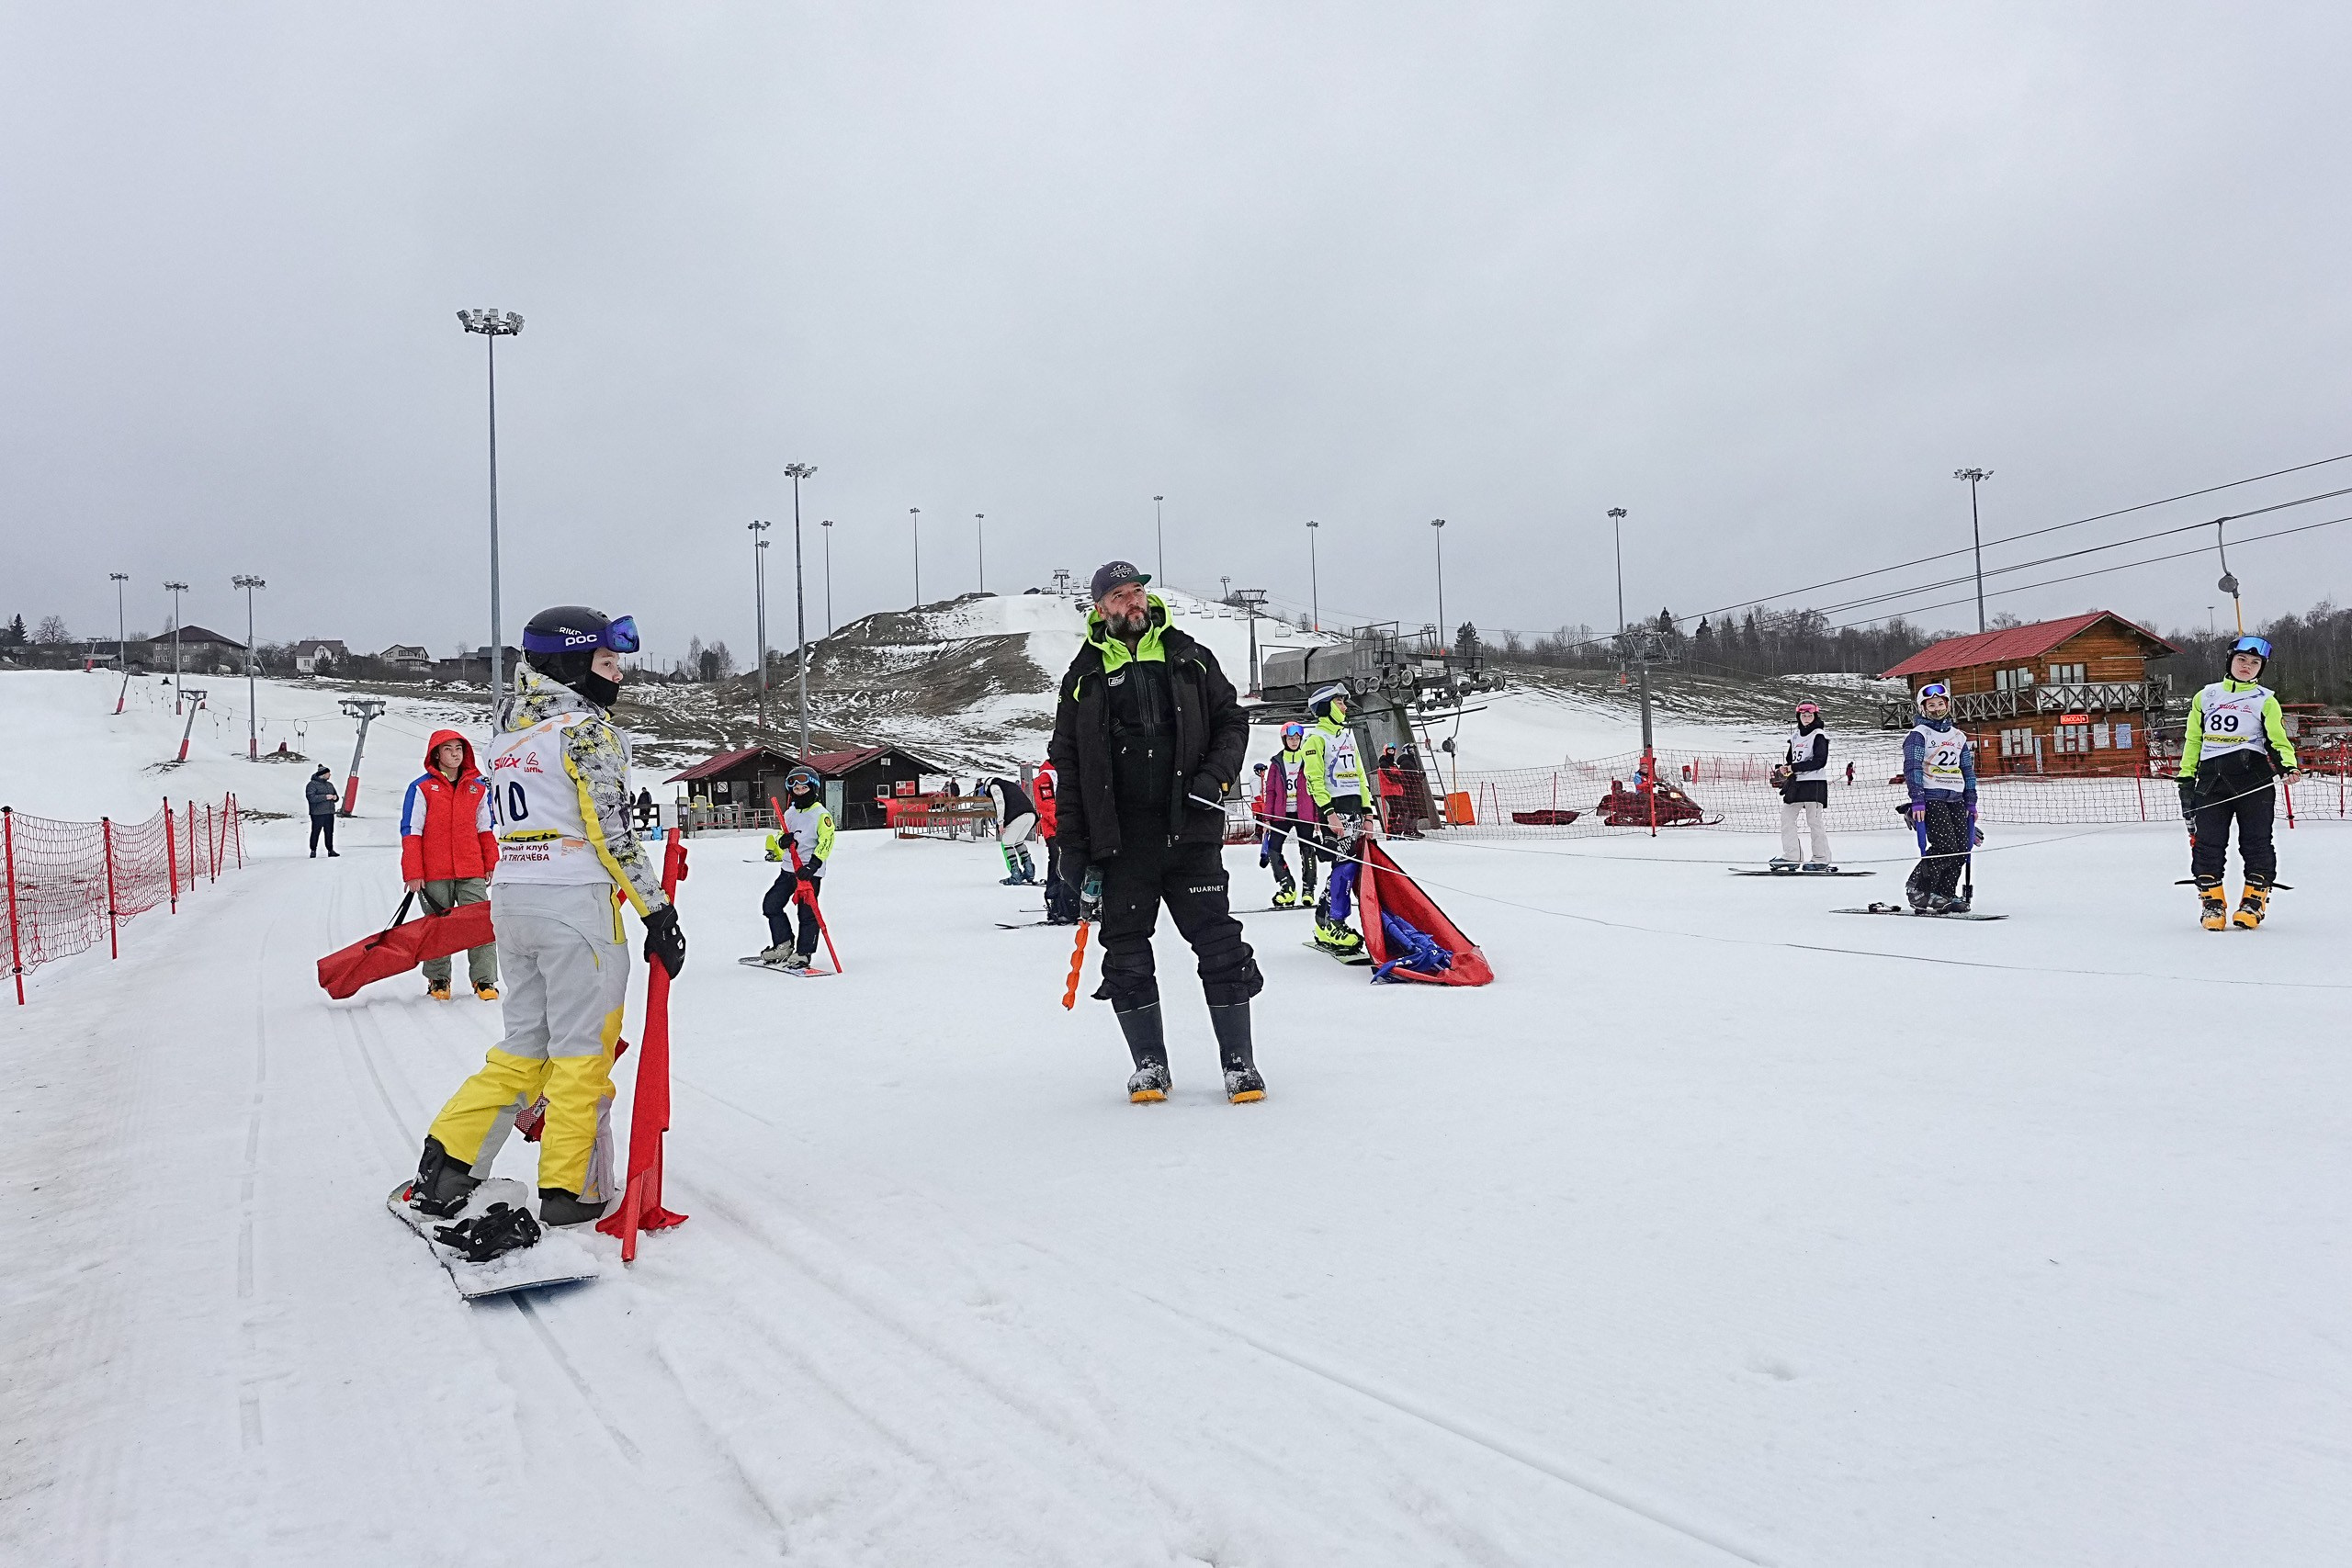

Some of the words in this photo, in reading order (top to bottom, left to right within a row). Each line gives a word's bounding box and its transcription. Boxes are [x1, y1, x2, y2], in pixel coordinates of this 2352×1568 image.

[2211, 714, 2239, 732] 89
[1339, 753, 1355, 769] 77
[1938, 750, 1958, 766] 22
[526, 842, 549, 852] клуб
